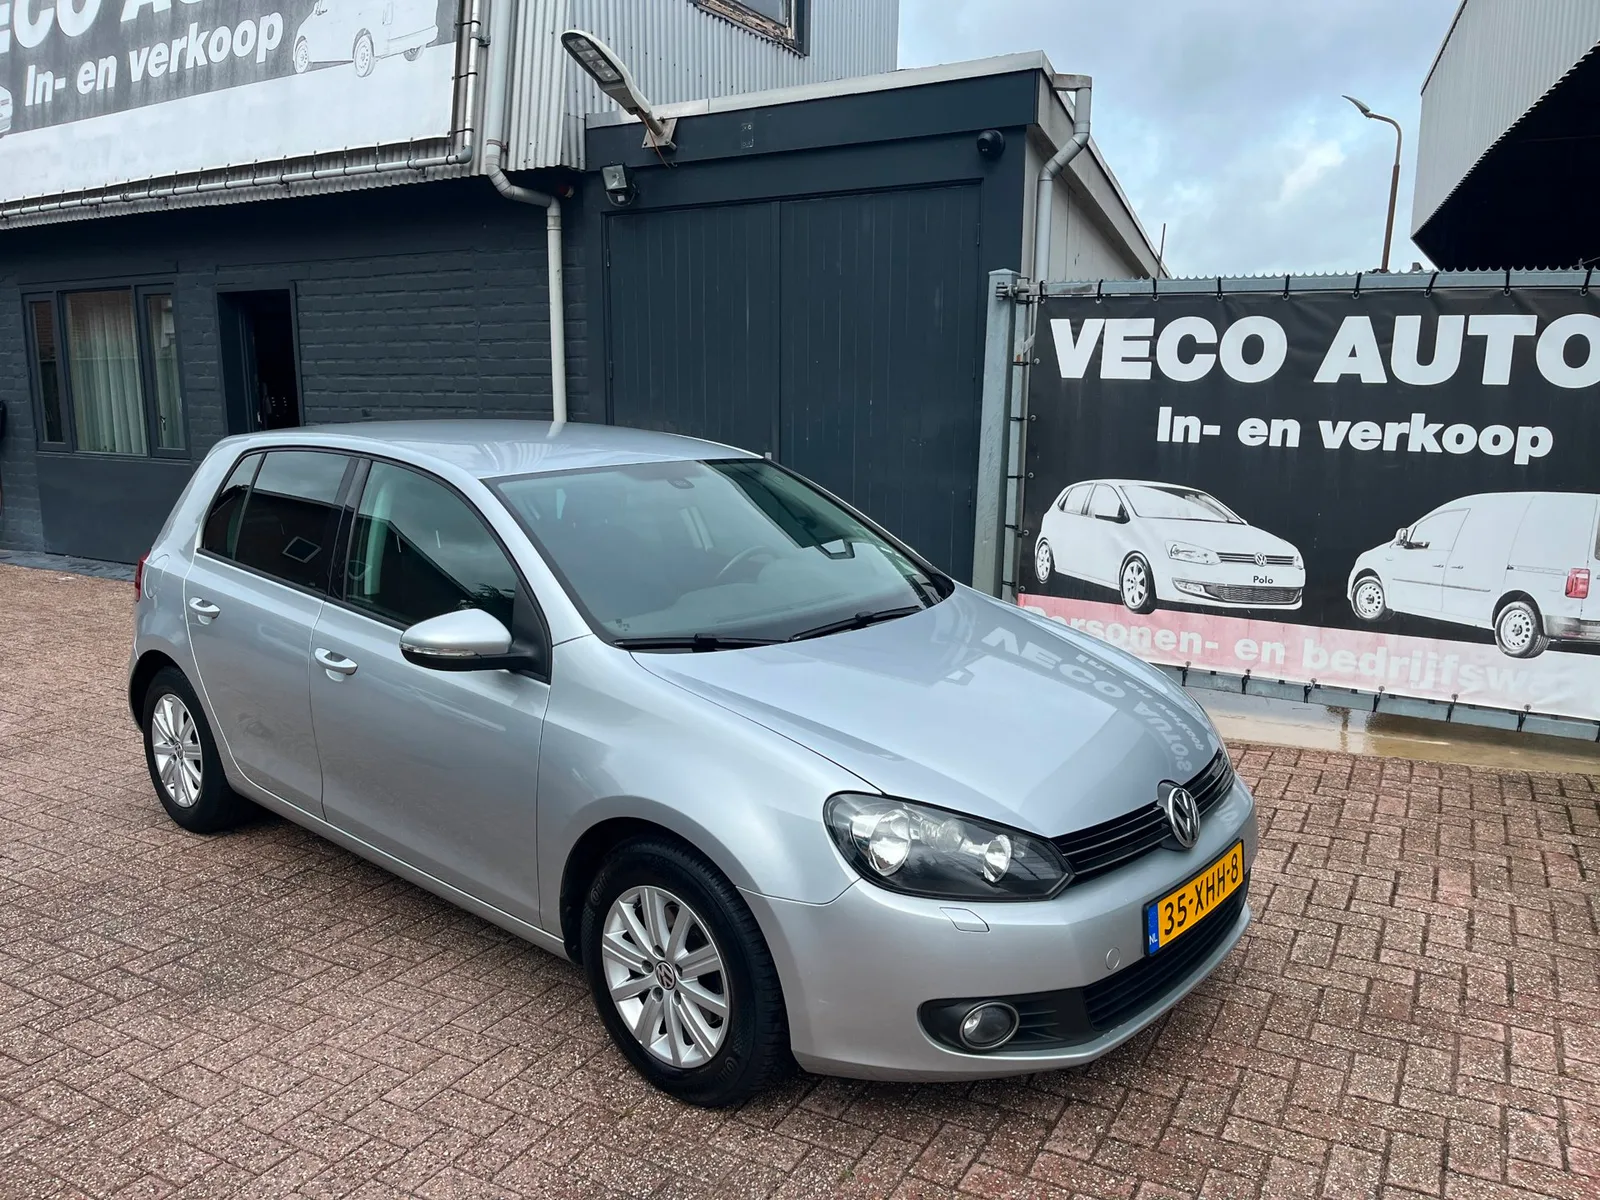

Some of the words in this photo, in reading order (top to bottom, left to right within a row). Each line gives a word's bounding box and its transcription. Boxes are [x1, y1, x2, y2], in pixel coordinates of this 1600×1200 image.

[25, 64, 66, 107] In-
[76, 54, 118, 95] en
[128, 12, 284, 83] verkoop
[1049, 315, 1288, 383] VECO
[1313, 313, 1600, 389] AUTO
[1156, 406, 1221, 444] In-
[1237, 417, 1300, 448] en
[1318, 413, 1553, 466] verkoop
[1253, 575, 1274, 584] Polo
[1234, 638, 1286, 664] en
[1164, 853, 1239, 936] 35-XHH-8
[1149, 932, 1158, 946] NL
